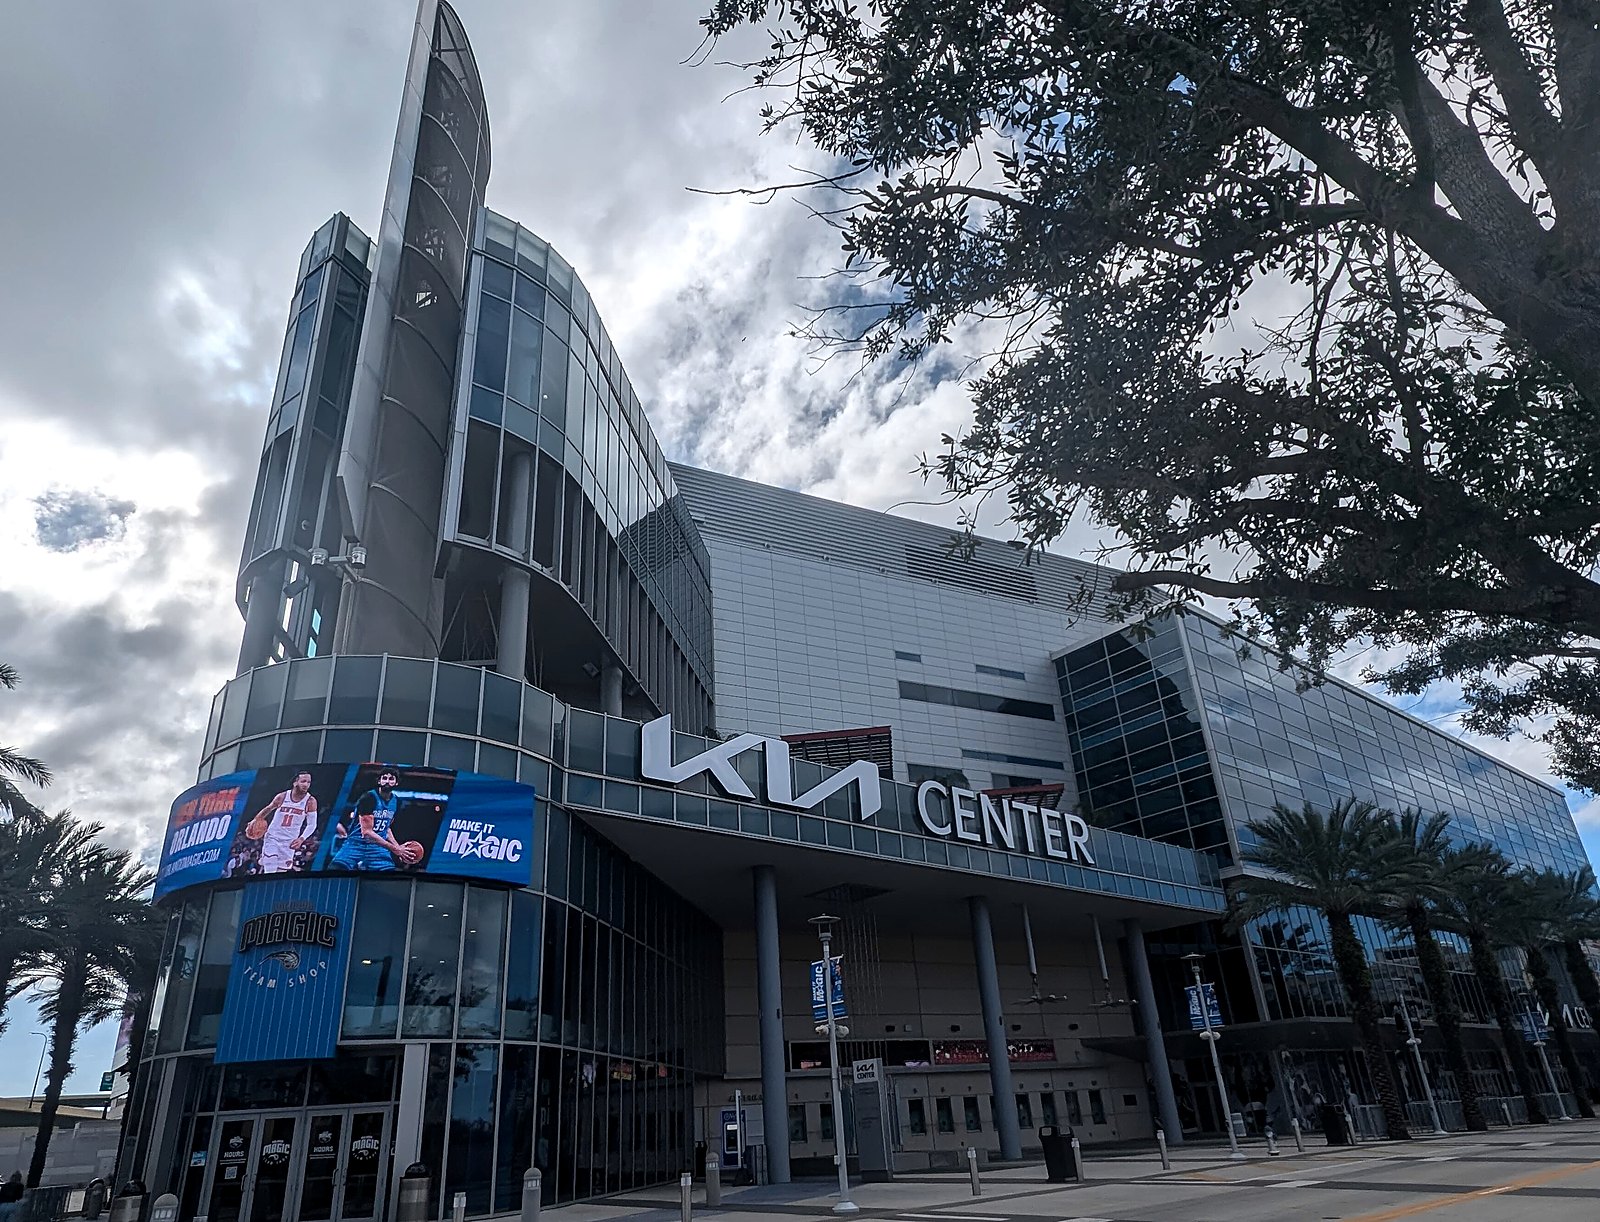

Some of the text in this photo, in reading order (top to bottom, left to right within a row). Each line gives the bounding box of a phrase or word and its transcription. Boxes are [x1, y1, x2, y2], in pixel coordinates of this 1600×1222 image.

[641, 713, 881, 821] KIA
[169, 814, 232, 855] ORLANDO
[372, 818, 388, 831] 35
[449, 818, 496, 834] MAKE IT
[917, 779, 1095, 865] CENTER
[238, 911, 337, 952] MAGIC
[243, 961, 327, 989] TEAM SHOP
[262, 1143, 291, 1156] MAGIC
[352, 1138, 380, 1152] MAGIC
